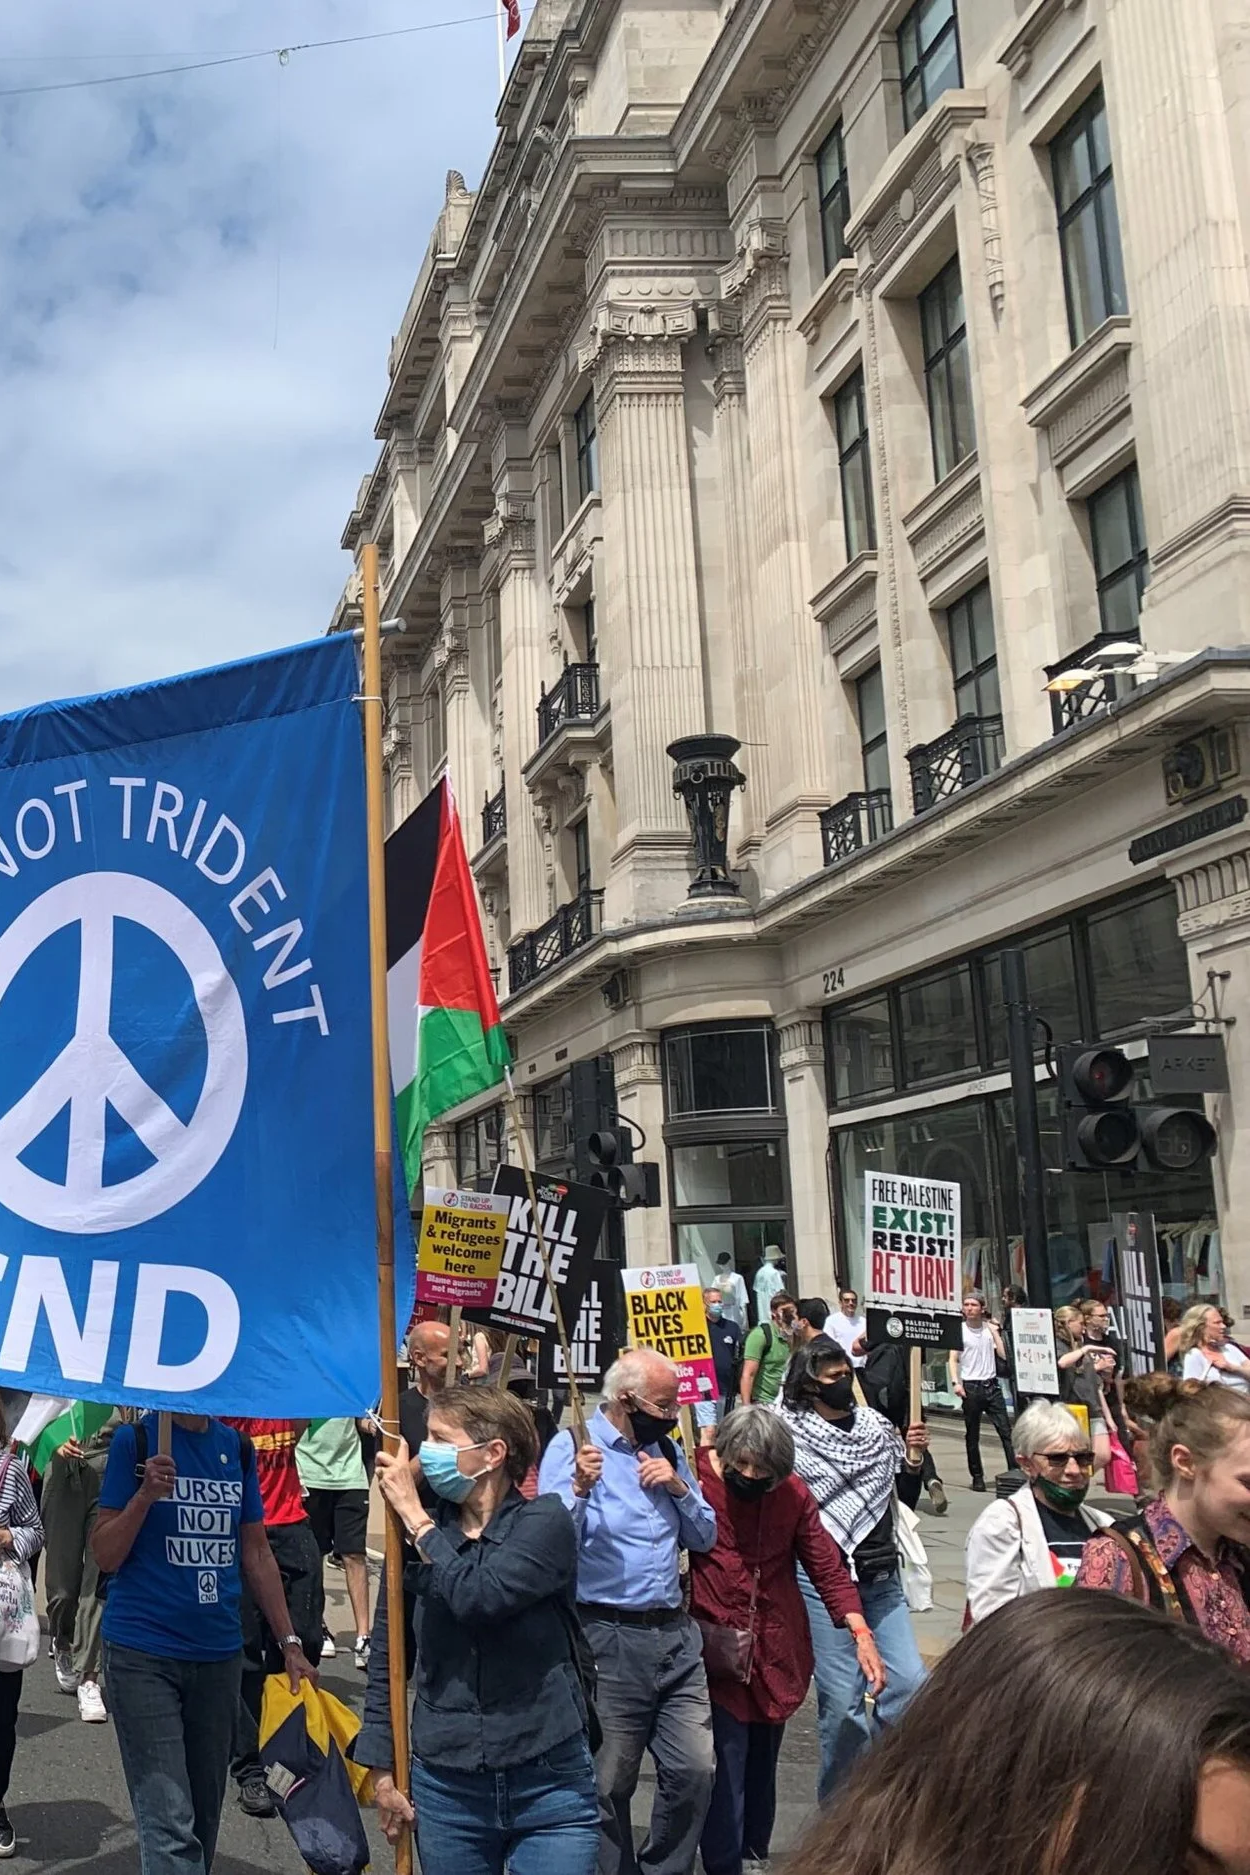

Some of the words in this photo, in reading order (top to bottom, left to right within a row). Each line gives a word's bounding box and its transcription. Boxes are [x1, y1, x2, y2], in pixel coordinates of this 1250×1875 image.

[109, 776, 330, 1036] TRIDENT
[823, 967, 845, 994] 224
[469, 1202, 493, 1211] RACISM
[872, 1178, 898, 1205] FREE
[901, 1182, 954, 1211] PALESTINE
[434, 1210, 497, 1230] Migrants
[507, 1195, 579, 1246] KILL
[872, 1205, 955, 1238] EXIST!
[426, 1224, 437, 1239] &
[440, 1228, 501, 1247] refugees
[872, 1230, 955, 1259] RESIST!
[432, 1243, 492, 1261] welcome
[502, 1230, 575, 1285] THE
[444, 1258, 476, 1274] here
[871, 1250, 955, 1301] RETURN!
[426, 1274, 451, 1286] Blame
[432, 1285, 445, 1293] not
[447, 1286, 481, 1297] migrants
[493, 1270, 558, 1324] BILL
[631, 1290, 688, 1316] BLACK
[572, 1309, 602, 1342] HE
[633, 1313, 684, 1338] LIVES
[905, 1319, 941, 1329] PALESTINE
[905, 1325, 944, 1336] SOLIDARITY
[905, 1332, 940, 1342] CAMPAIGN
[170, 1478, 241, 1505] URSES
[179, 1507, 230, 1533] NOT
[201, 1593, 217, 1602] CND
